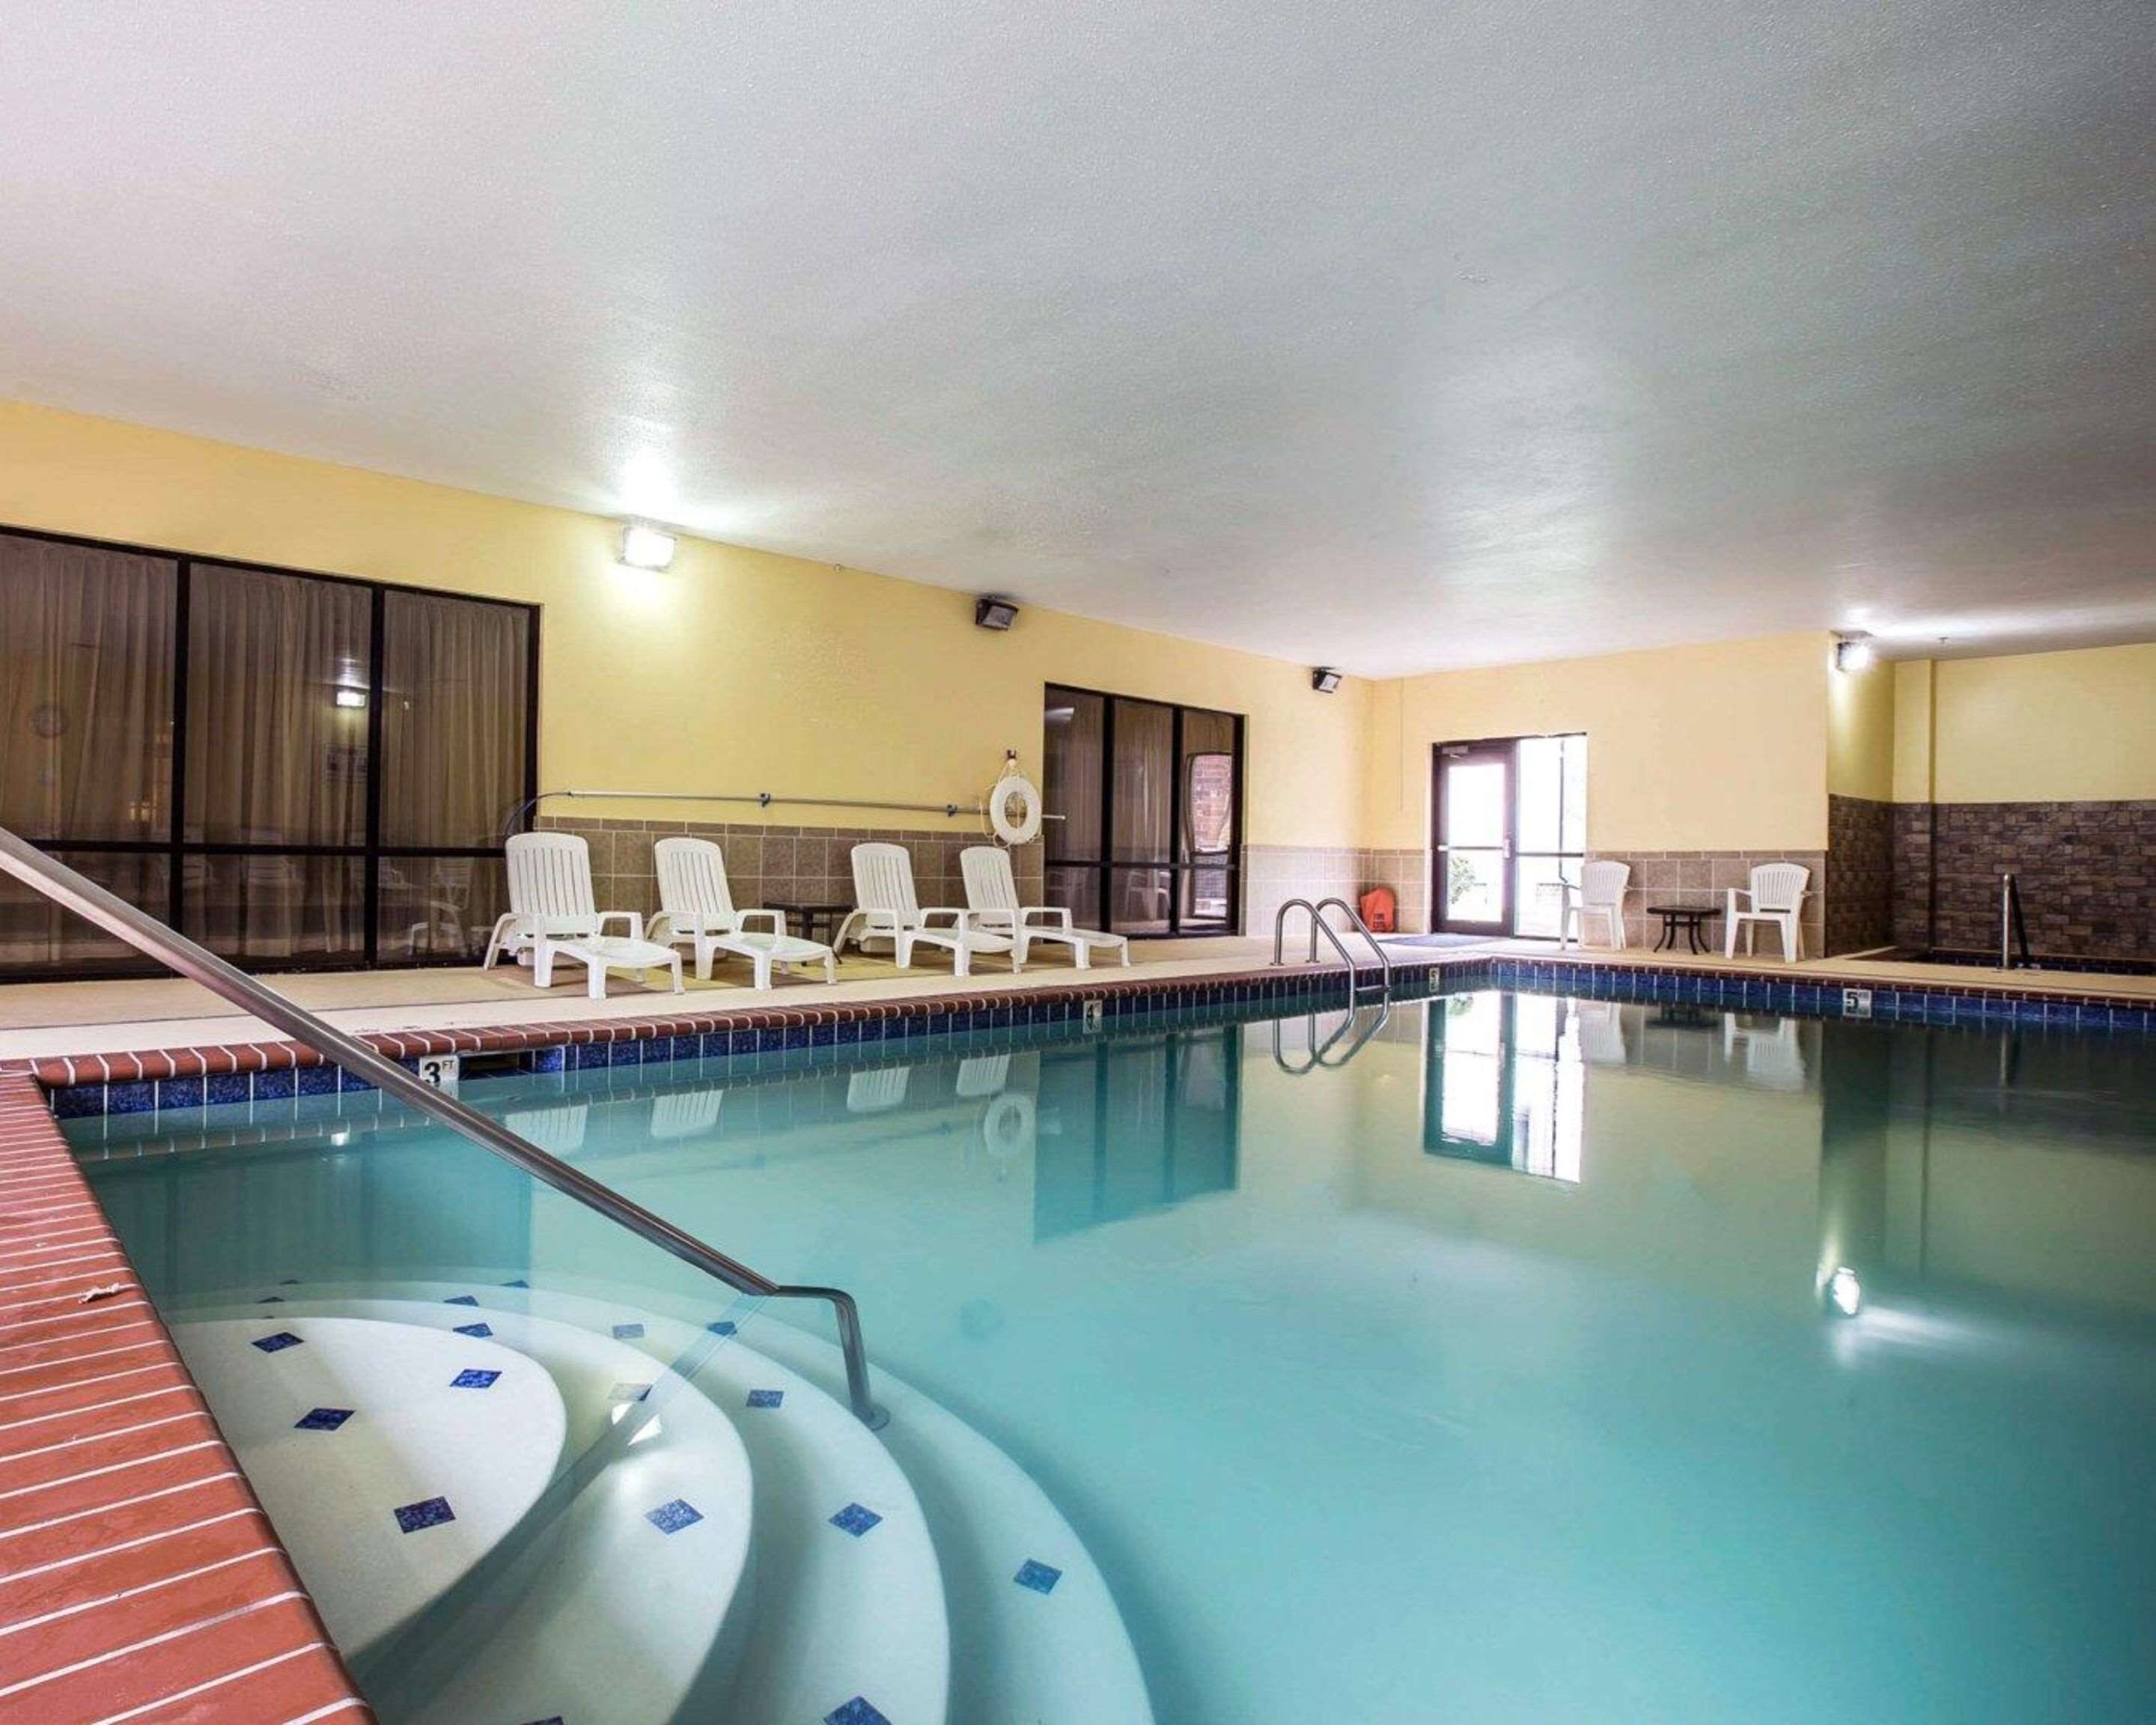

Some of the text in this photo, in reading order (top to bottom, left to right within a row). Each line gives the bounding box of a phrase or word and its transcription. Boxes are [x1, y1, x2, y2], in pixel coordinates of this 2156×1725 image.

[1847, 991, 1858, 1009] 5
[424, 1060, 454, 1084] 3 FT
